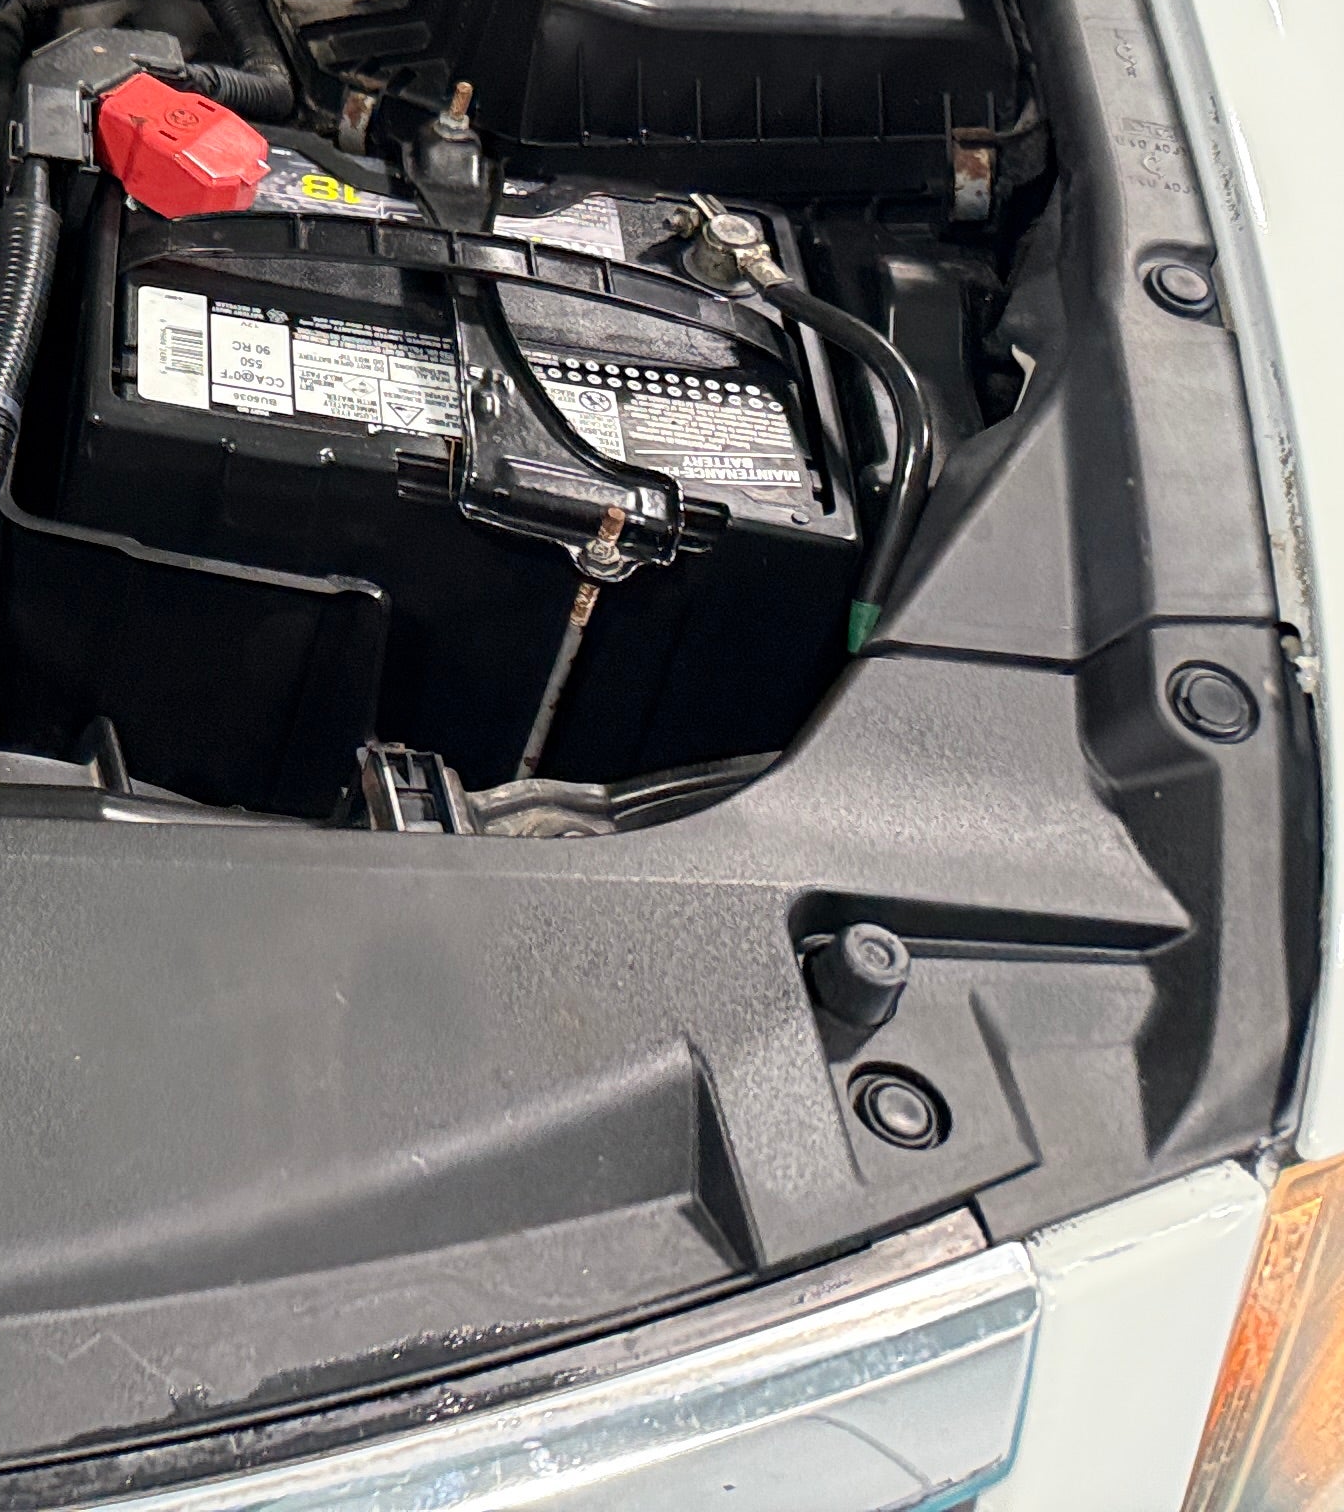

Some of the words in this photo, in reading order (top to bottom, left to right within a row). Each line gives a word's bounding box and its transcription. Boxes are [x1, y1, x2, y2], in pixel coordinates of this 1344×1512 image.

[232, 340, 252, 353] RC
[256, 344, 271, 355] 90
[241, 356, 263, 369] 550
[682, 455, 754, 469] BATTERY
